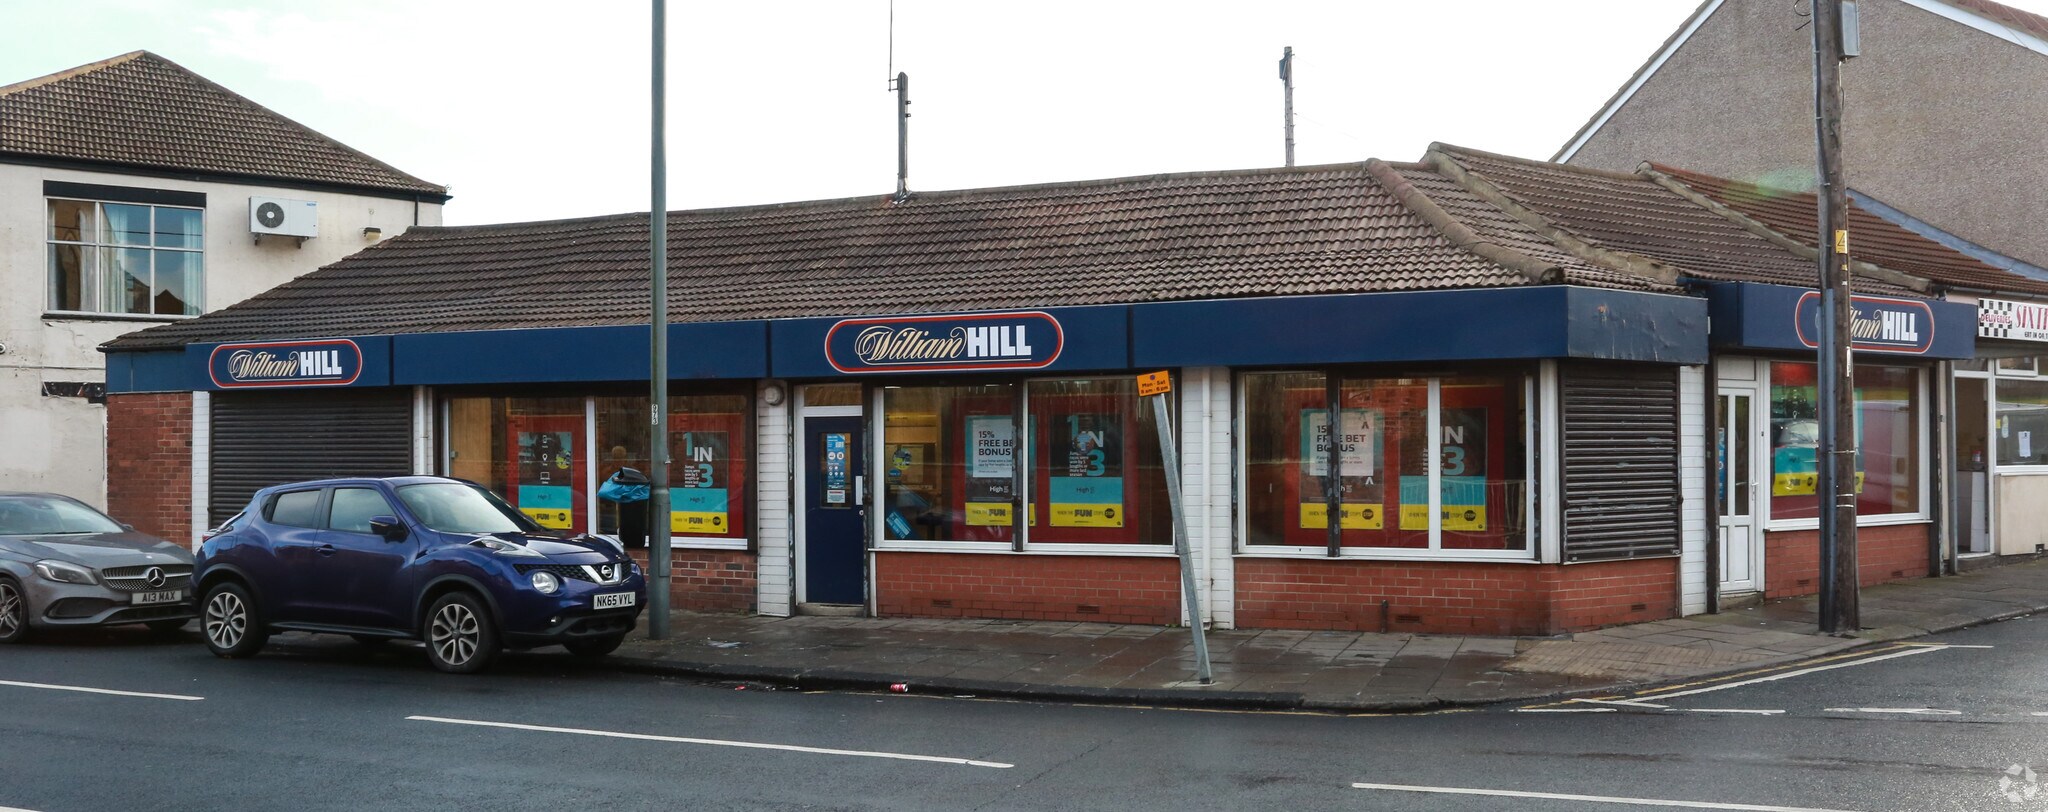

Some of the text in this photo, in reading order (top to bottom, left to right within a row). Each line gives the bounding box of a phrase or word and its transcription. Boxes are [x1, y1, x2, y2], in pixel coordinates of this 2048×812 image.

[1882, 310, 1918, 342] HILL
[1981, 313, 2011, 325] DELIVERIES
[853, 325, 1032, 365] William HILL
[228, 349, 342, 379] William HILL
[683, 432, 693, 456] 1
[1345, 435, 1366, 443] BET
[694, 447, 713, 462] IN
[978, 448, 1011, 456] BONUS
[1086, 449, 1105, 477] 3
[1444, 446, 1465, 476] 3
[698, 463, 714, 488] 3
[988, 508, 1006, 517] FUN
[1074, 509, 1092, 517] FUN
[159, 591, 176, 601] MAX
[596, 594, 632, 607] NK65 VYL
